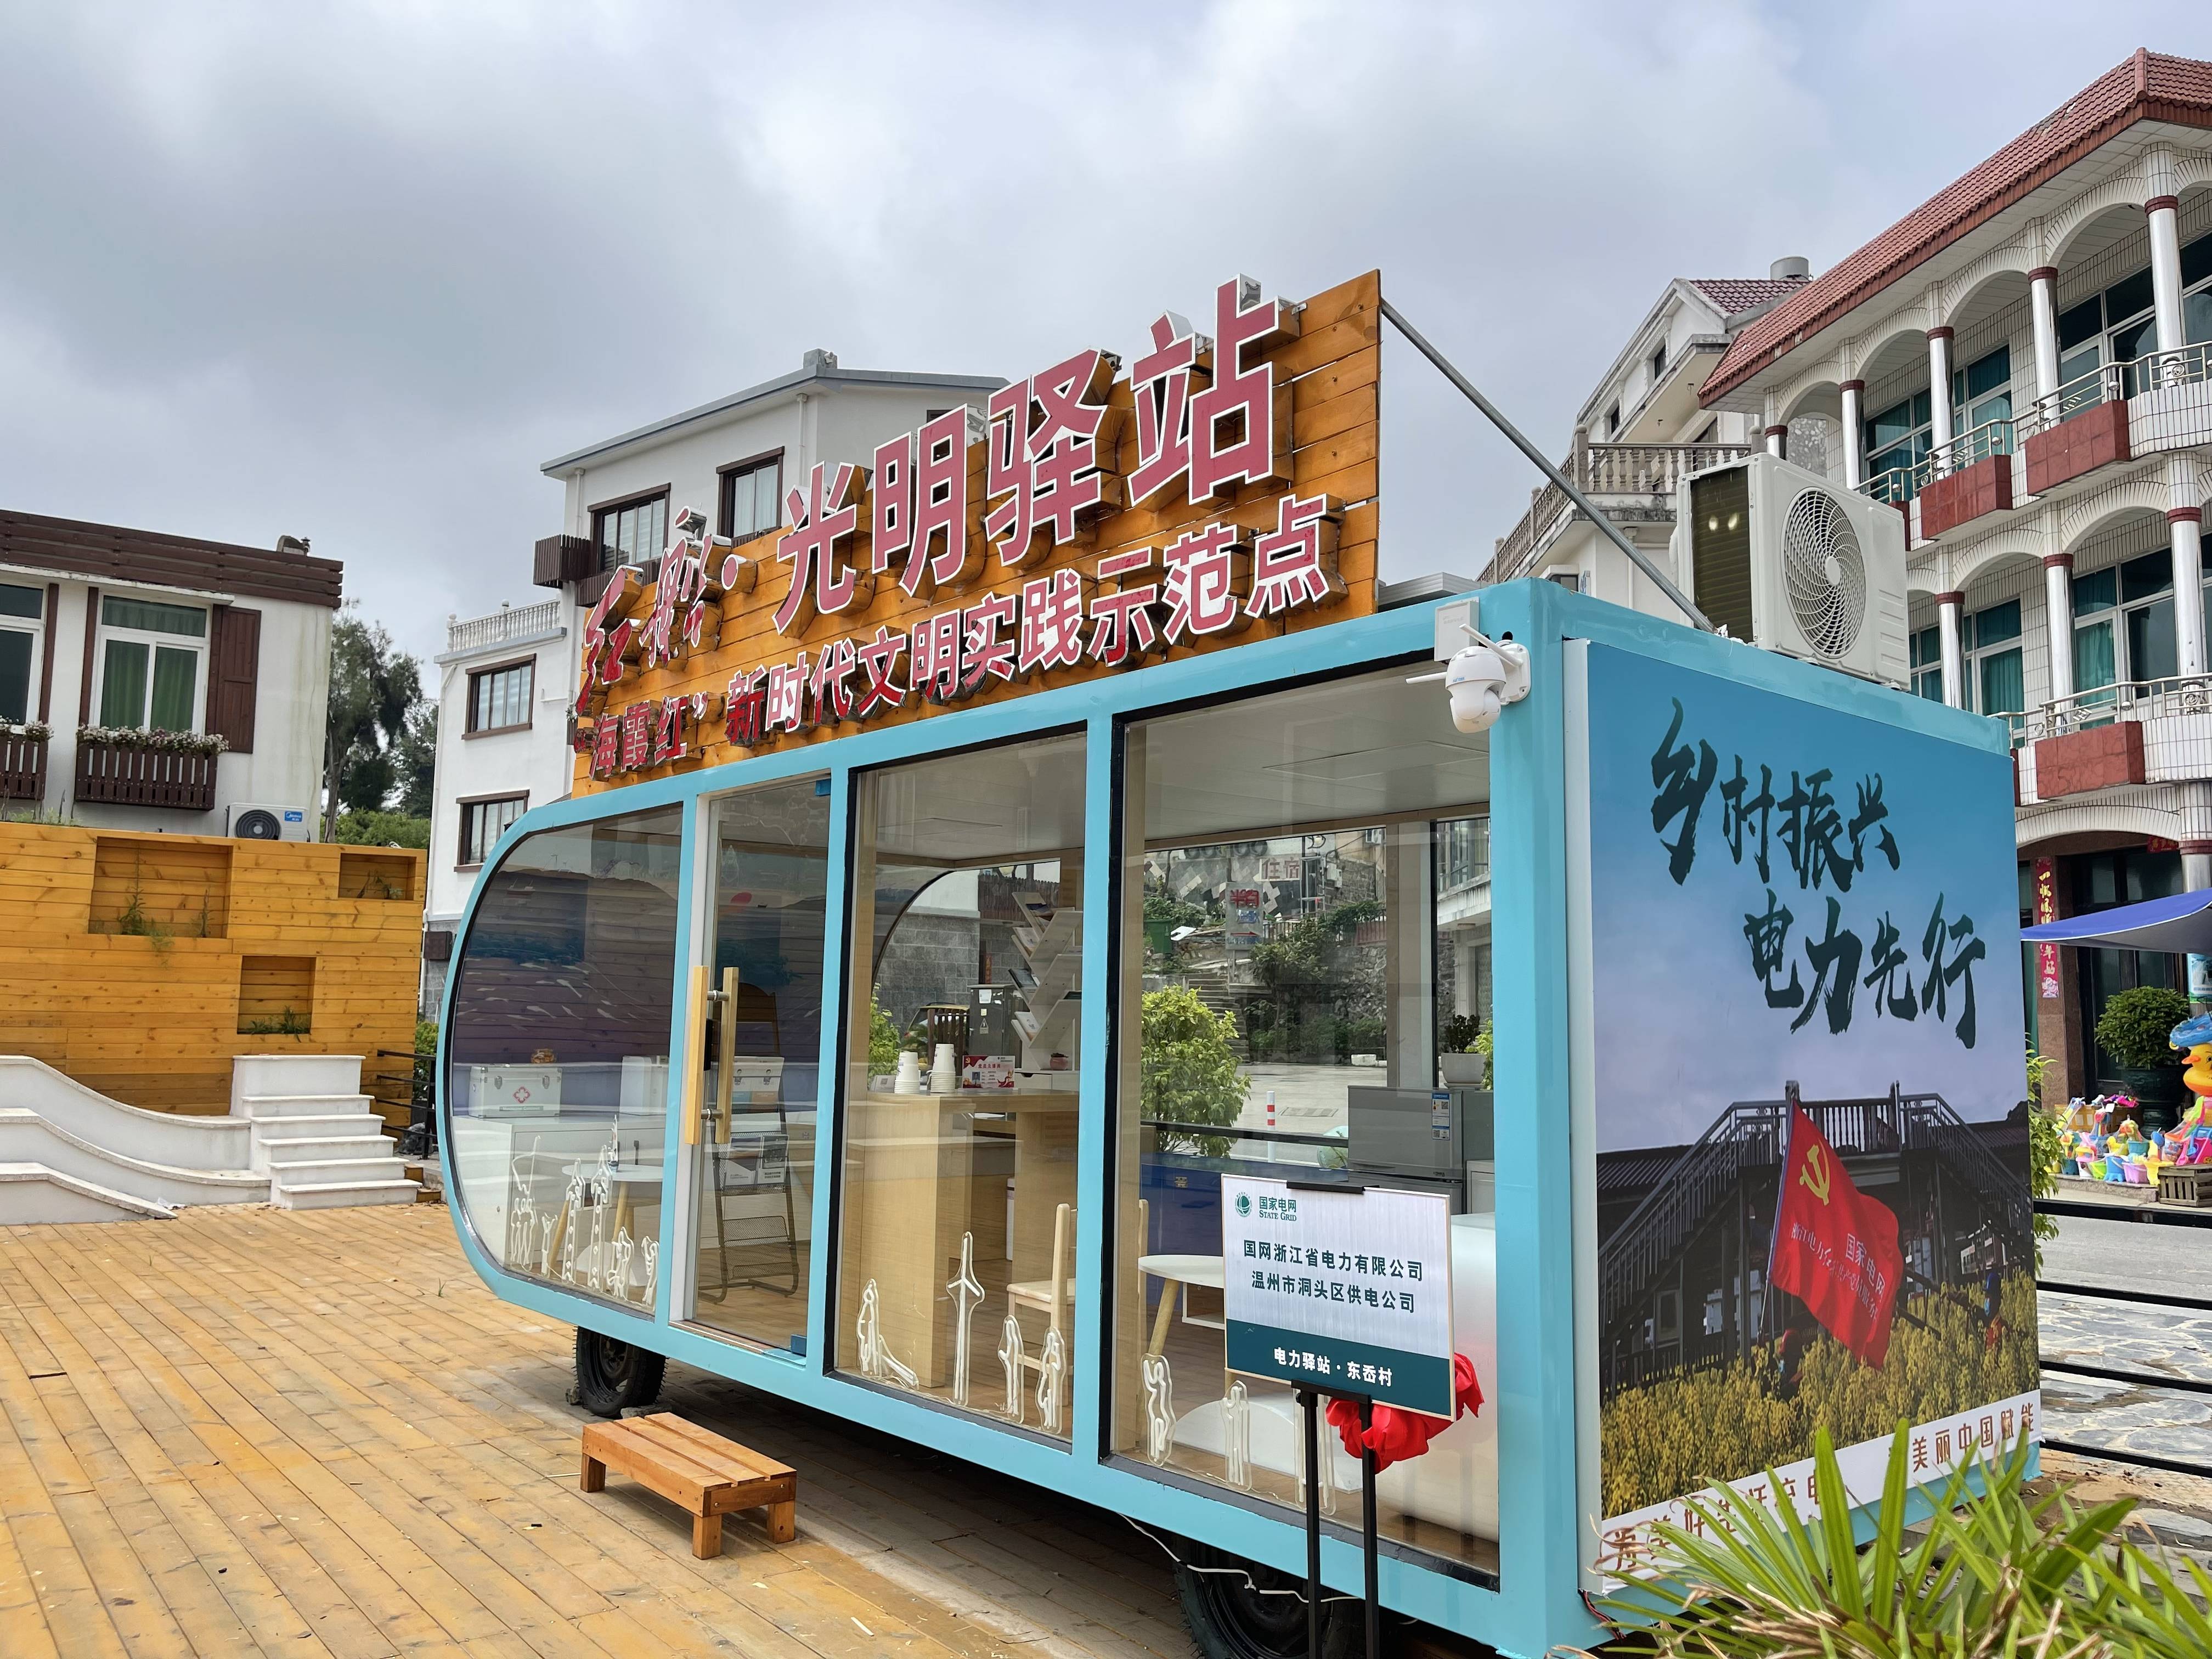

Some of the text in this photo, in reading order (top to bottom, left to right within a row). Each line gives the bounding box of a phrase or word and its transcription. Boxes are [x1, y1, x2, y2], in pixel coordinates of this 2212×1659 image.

[1651, 697, 1900, 892] 乡村振兴
[1744, 889, 1985, 1049] 电力先行
[1259, 1196, 1296, 1213] 国家电网
[1244, 1239, 1423, 1282] 国网浙江省电力有限公司
[1846, 1233, 1886, 1299] 国家电网
[1251, 1270, 1415, 1313] 温州市洞头区供电公司
